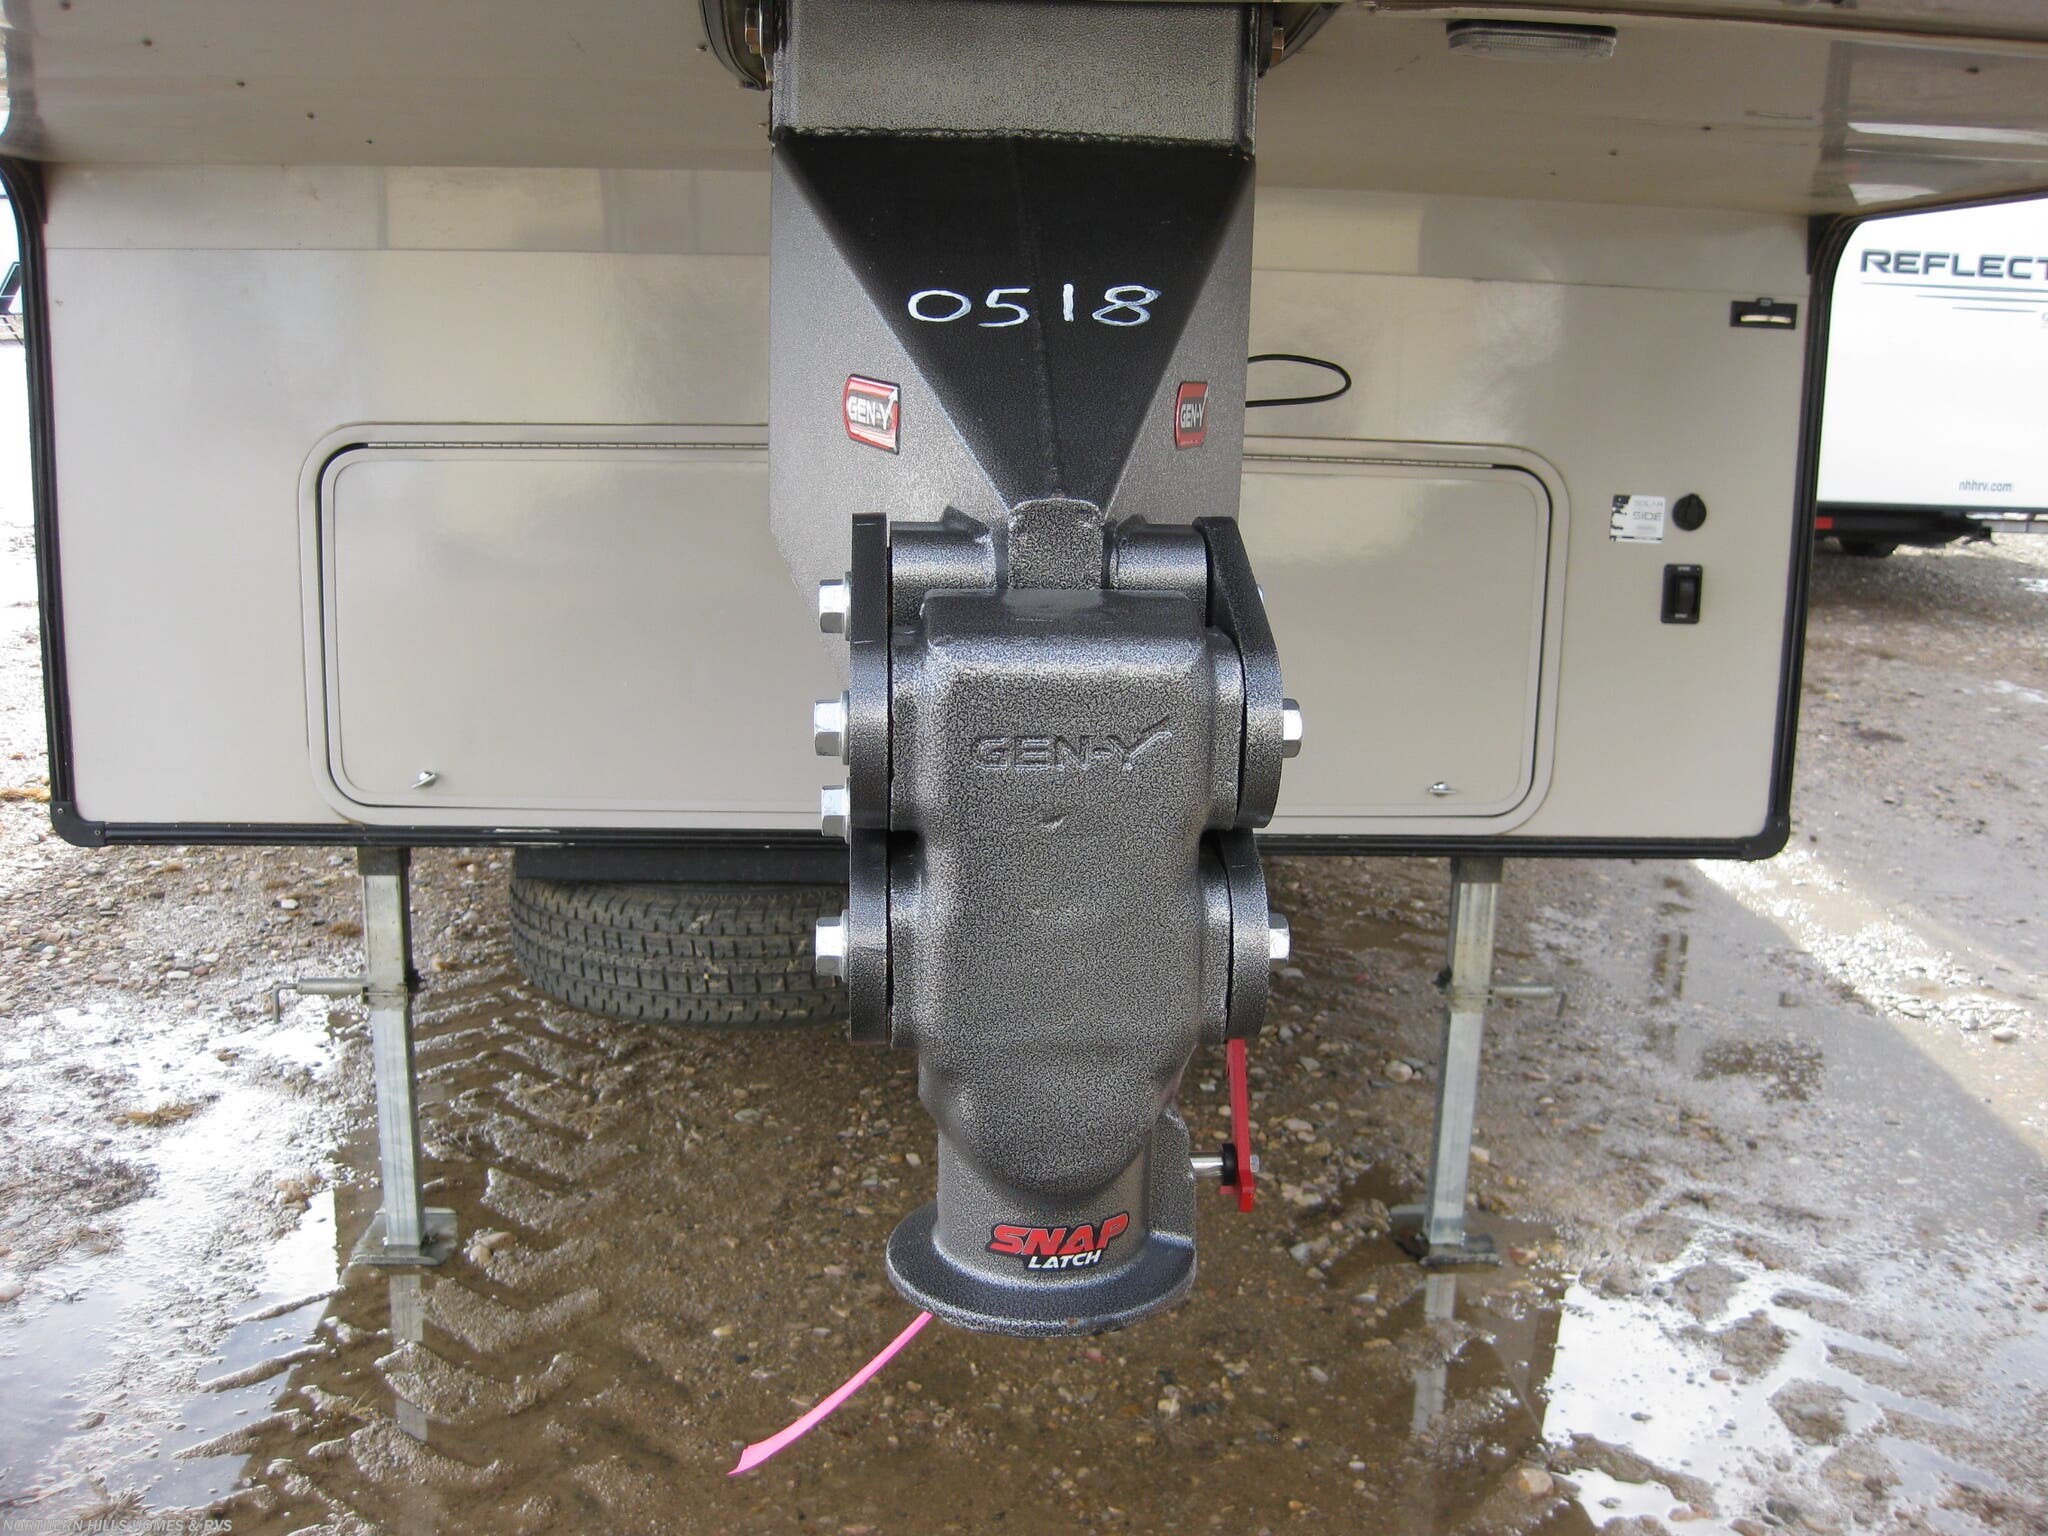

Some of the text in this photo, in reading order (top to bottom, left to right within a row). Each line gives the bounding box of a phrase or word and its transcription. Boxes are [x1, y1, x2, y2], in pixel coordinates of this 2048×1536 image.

[907, 284, 1161, 328] 0518
[848, 387, 899, 431] GEN-Y
[1180, 385, 1209, 429] GEN-Y
[1632, 511, 1663, 521] SIDE
[974, 714, 1173, 771] GEN-Y
[989, 1213, 1129, 1256] SNAP
[1027, 1249, 1102, 1269] LATCH
